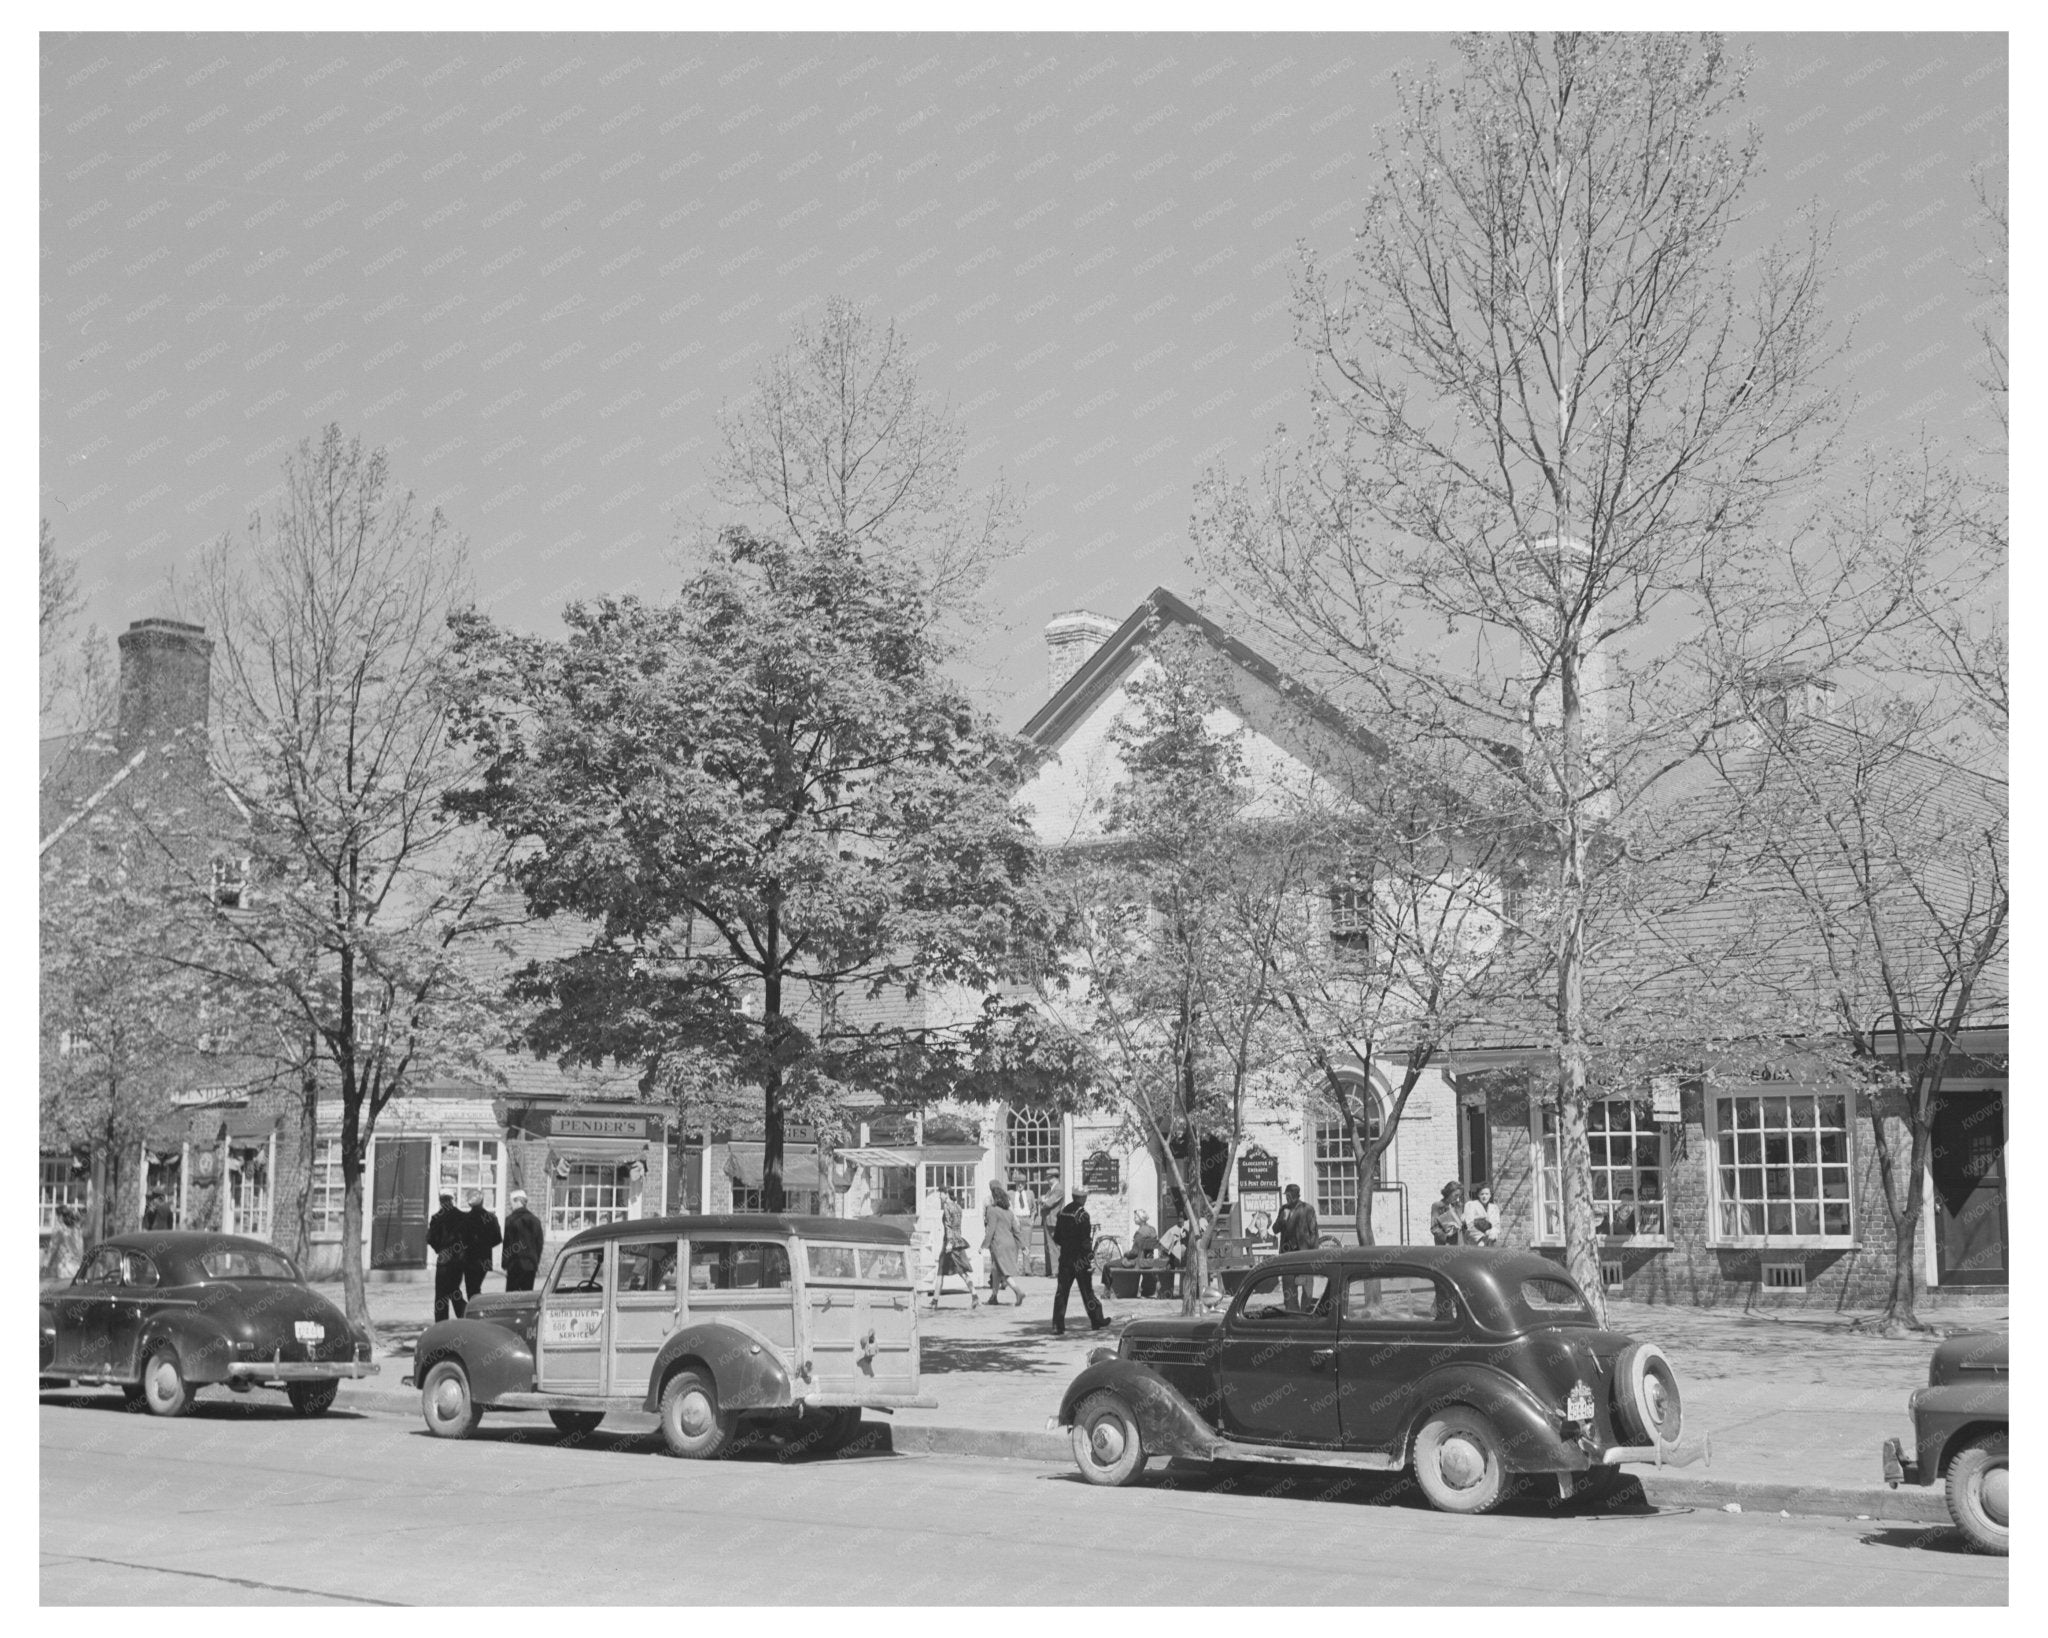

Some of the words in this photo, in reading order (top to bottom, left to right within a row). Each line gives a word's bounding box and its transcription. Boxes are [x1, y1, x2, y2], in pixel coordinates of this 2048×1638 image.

[560, 1120, 636, 1133] PENDER'S
[1245, 1201, 1277, 1211] WAVES
[560, 1331, 589, 1339] SERVICE
